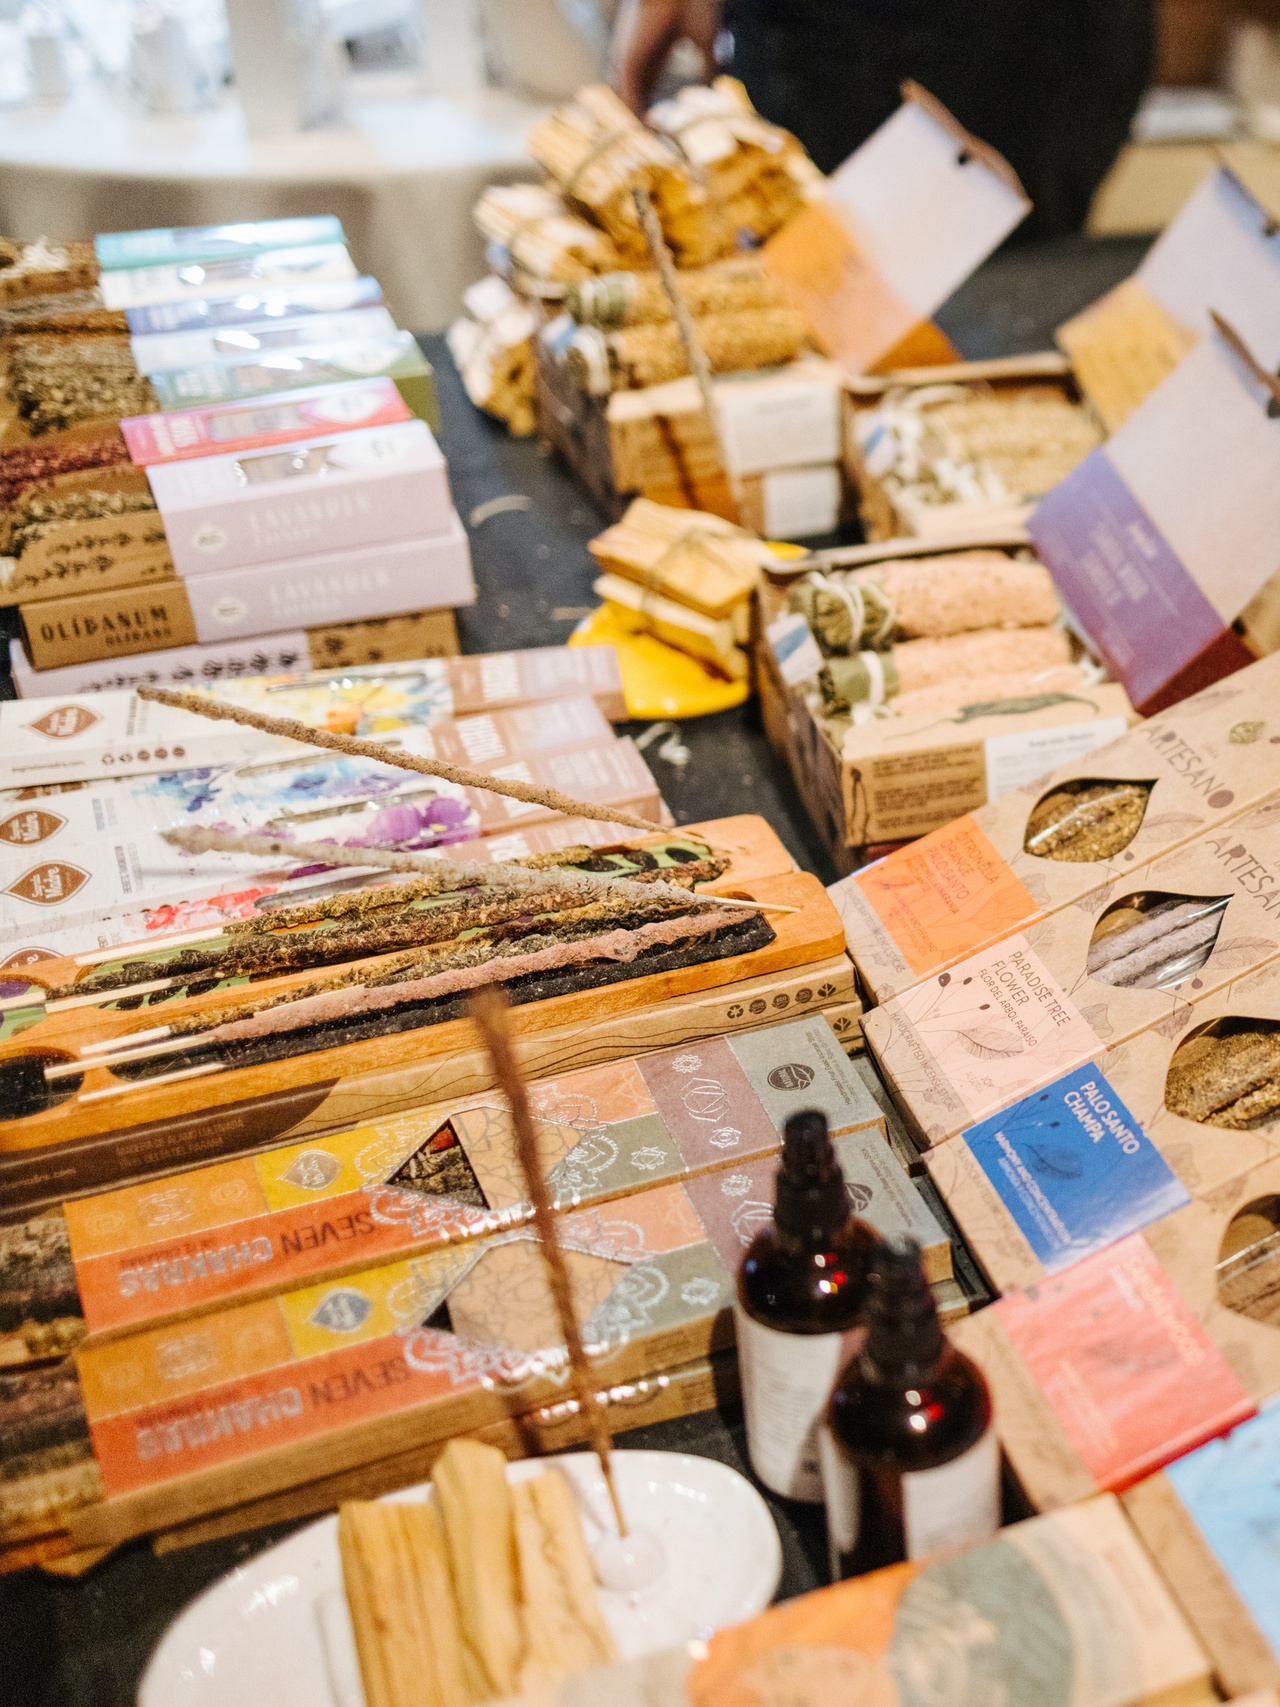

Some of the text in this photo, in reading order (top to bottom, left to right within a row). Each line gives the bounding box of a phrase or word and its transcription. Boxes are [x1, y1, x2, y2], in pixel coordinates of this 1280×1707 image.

[1140, 724, 1235, 809] ARTESANO
[22, 812, 40, 842] Madre
[940, 838, 974, 877] ORANGE
[956, 831, 1000, 885] CITRONELLA
[29, 873, 44, 899] Sagrada
[43, 866, 63, 900] Madre
[944, 871, 970, 899] SANTO
[870, 925, 892, 953] INCENSE
[886, 949, 905, 973] STICKS
[916, 926, 937, 953] HEALING
[978, 968, 994, 987] FLOR
[989, 985, 1000, 1002] DEL
[999, 998, 1016, 1023] ÁRBOL
[990, 960, 1030, 1007] FLOWER
[1008, 950, 1072, 1027] PARADISE TREE
[890, 1011, 957, 1112] HANDCRAFTED INCENSE STICKS
[1063, 1091, 1106, 1144] CHAMPA
[1080, 1080, 1140, 1155] PALO SANTO
[280, 1211, 375, 1256] SEVEN
[118, 1236, 273, 1297] CHAKRAS
[308, 1356, 411, 1406] SEVEN
[136, 1386, 303, 1461] CHAKRAS
